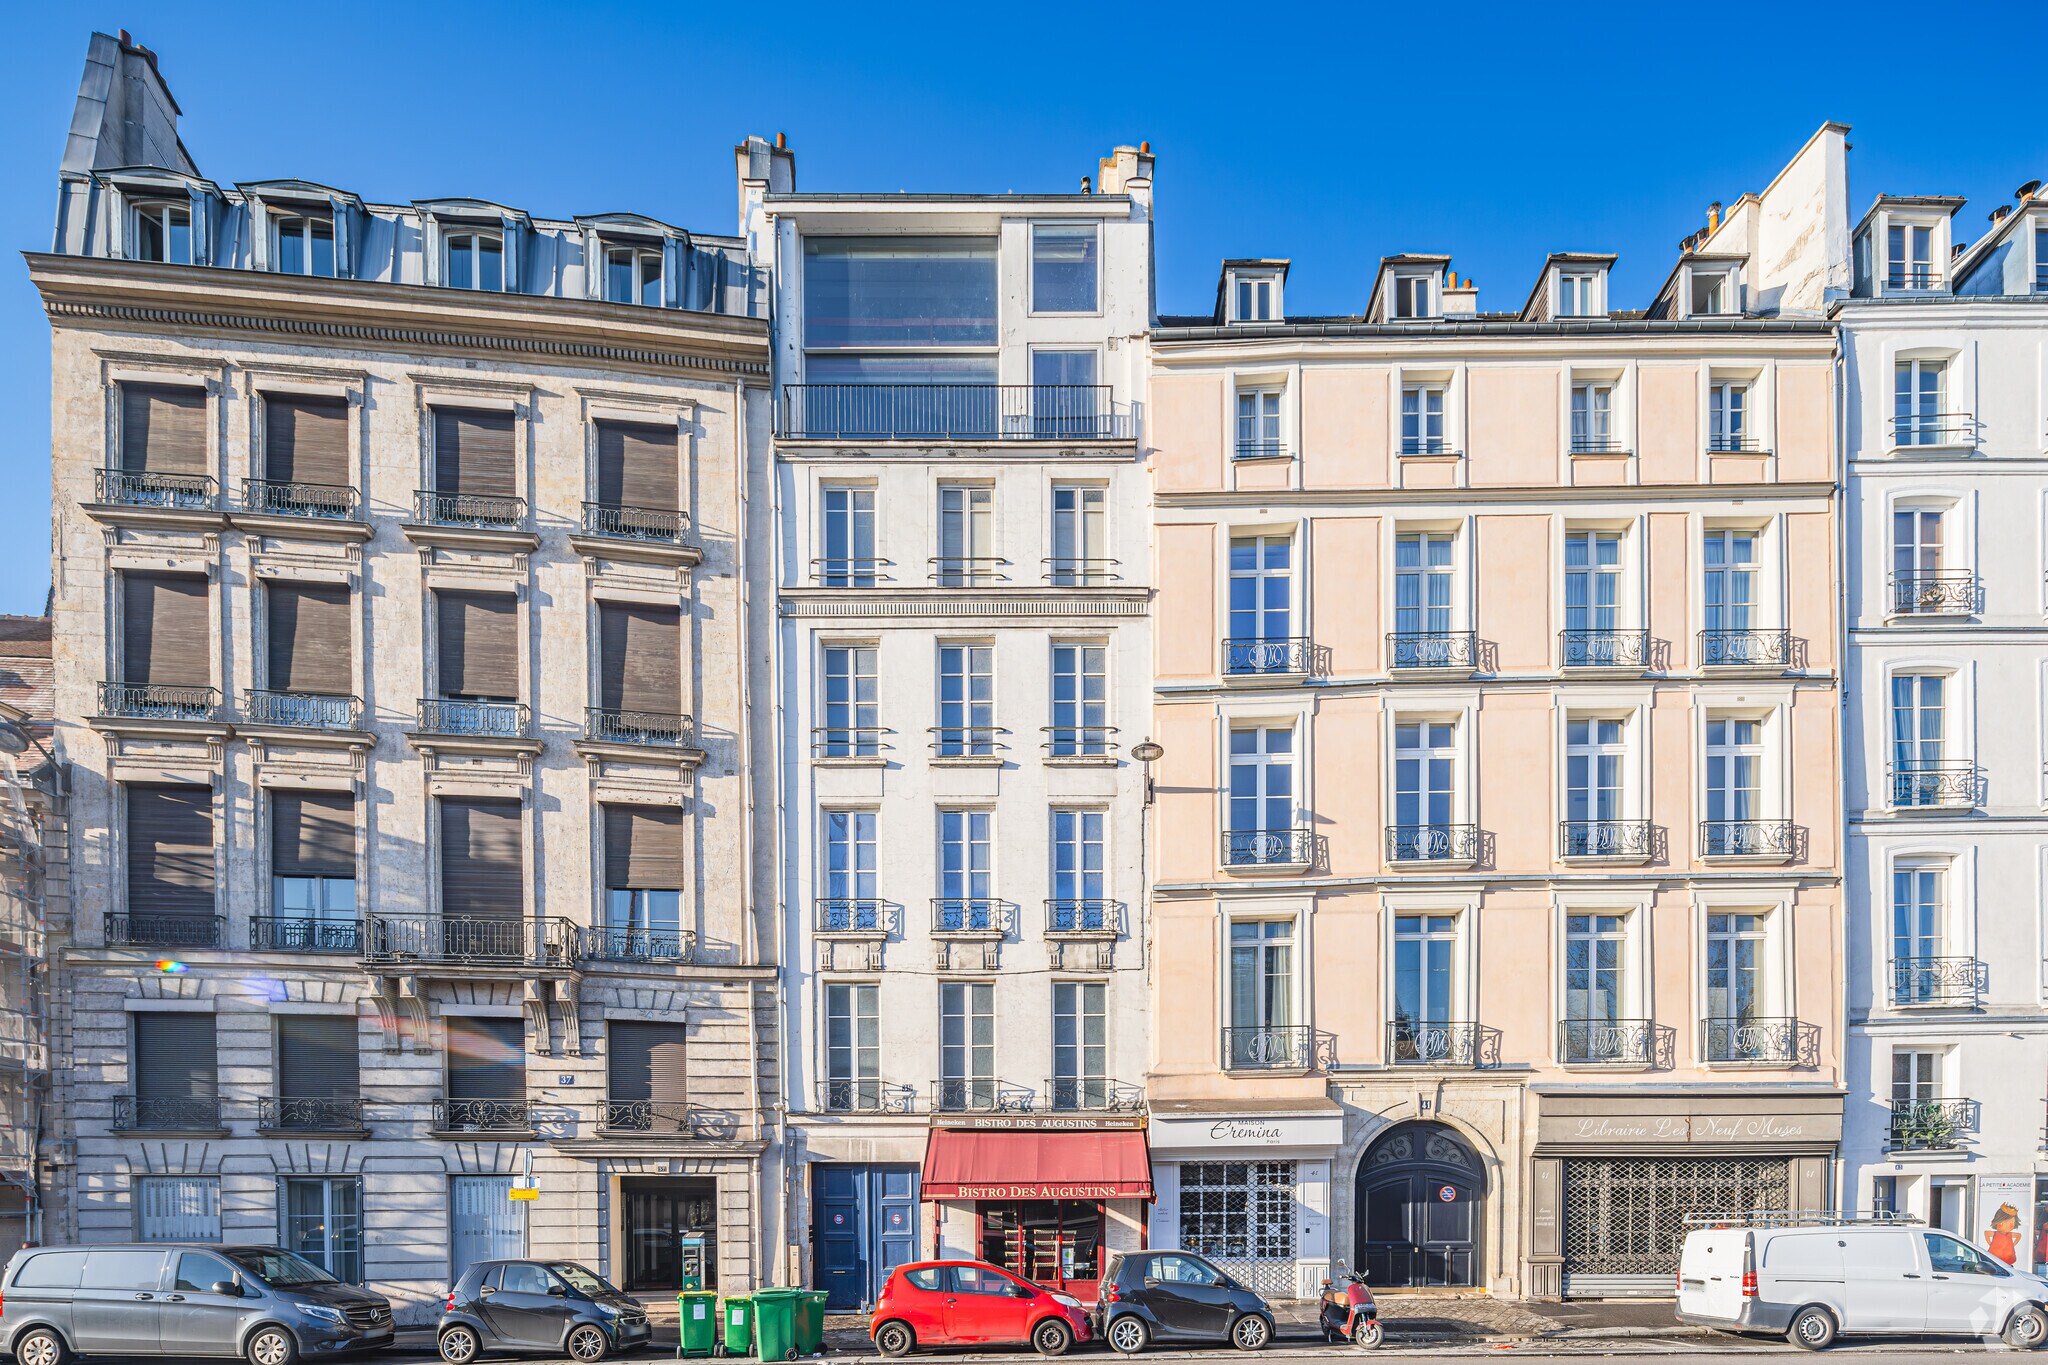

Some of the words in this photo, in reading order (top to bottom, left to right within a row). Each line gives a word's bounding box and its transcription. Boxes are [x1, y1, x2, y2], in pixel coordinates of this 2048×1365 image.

[560, 1075, 572, 1084] 37
[1421, 1101, 1430, 1109] 41
[974, 1119, 1011, 1127] BISTRO
[1041, 1119, 1097, 1128] AUGUSTINS
[1575, 1118, 1647, 1138] Librairie
[1653, 1118, 1686, 1138] Les
[1695, 1117, 1743, 1140] Neuf
[1747, 1116, 1802, 1138] Muses
[1210, 1119, 1283, 1140] Eremina
[957, 1186, 1006, 1198] BISTRO
[1009, 1186, 1036, 1197] DES
[1040, 1185, 1116, 1197] AUGUSTINS
